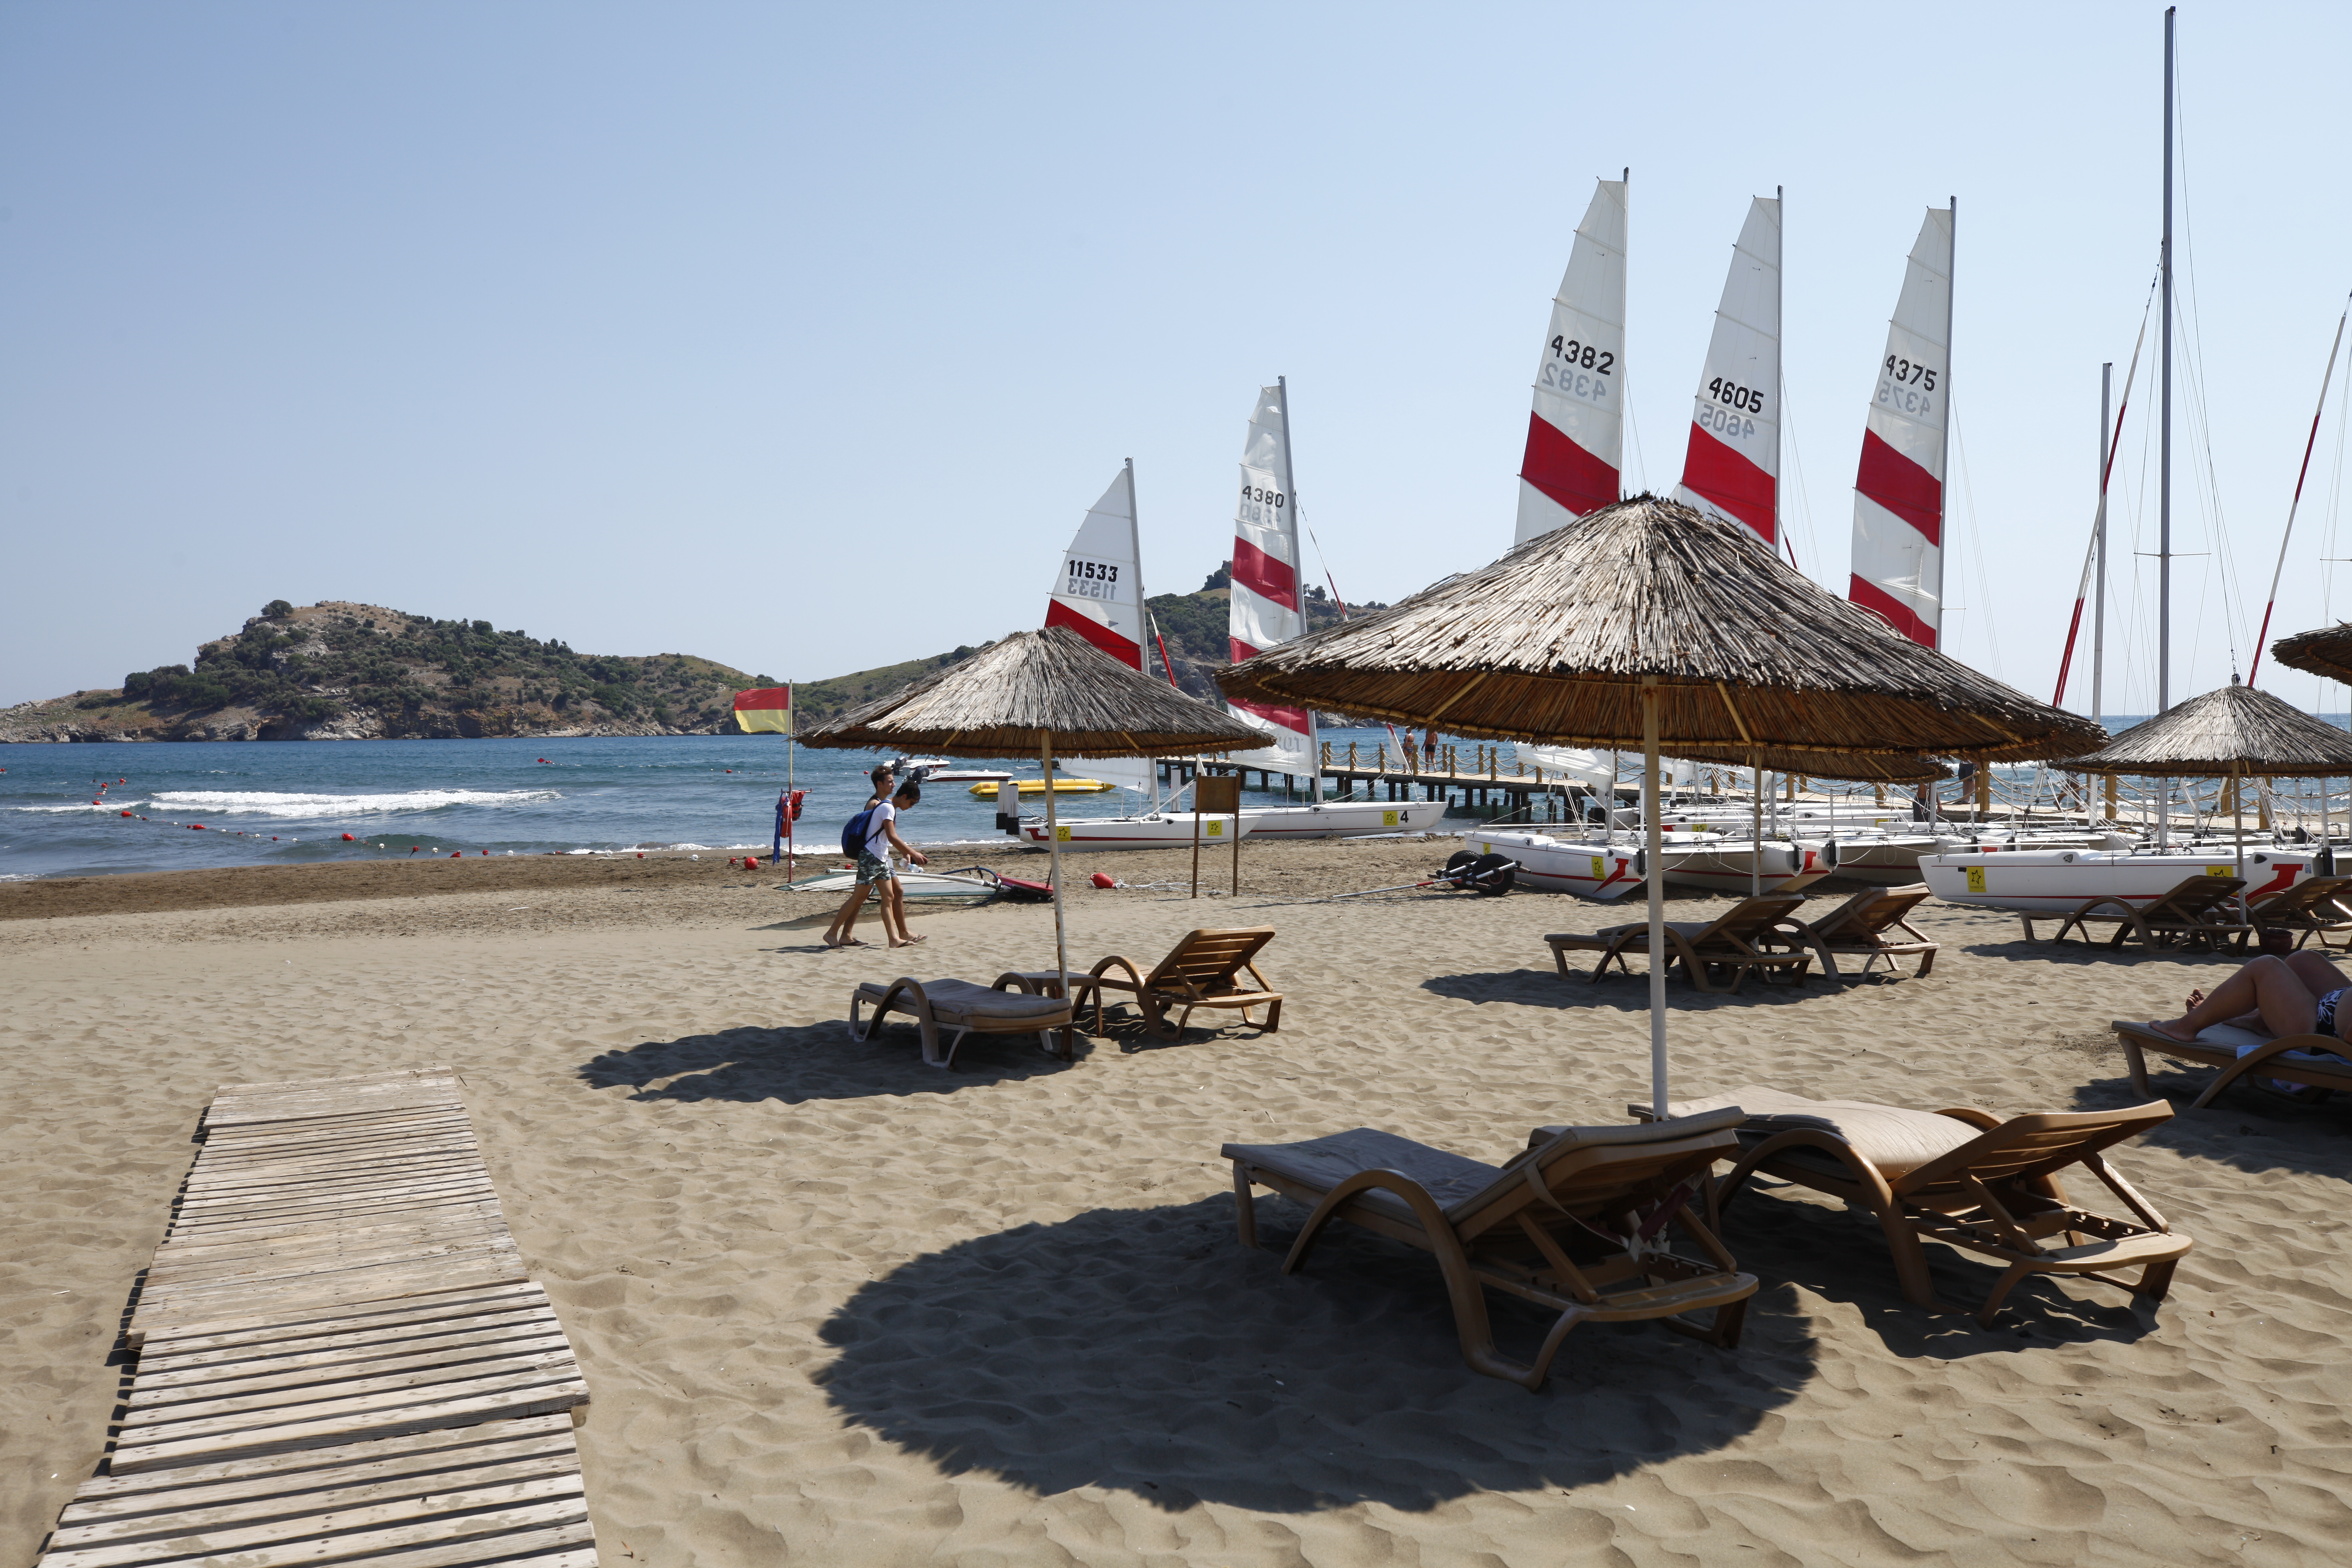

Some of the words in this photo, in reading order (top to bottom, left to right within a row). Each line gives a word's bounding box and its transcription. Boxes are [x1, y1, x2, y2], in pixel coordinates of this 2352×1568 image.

[1551, 335, 1614, 376] 4382
[1886, 354, 1937, 392] 4375
[1709, 377, 1764, 414] 4605
[1242, 486, 1284, 508] 4380
[1069, 560, 1118, 582] 11533
[1400, 810, 1409, 823] 4
